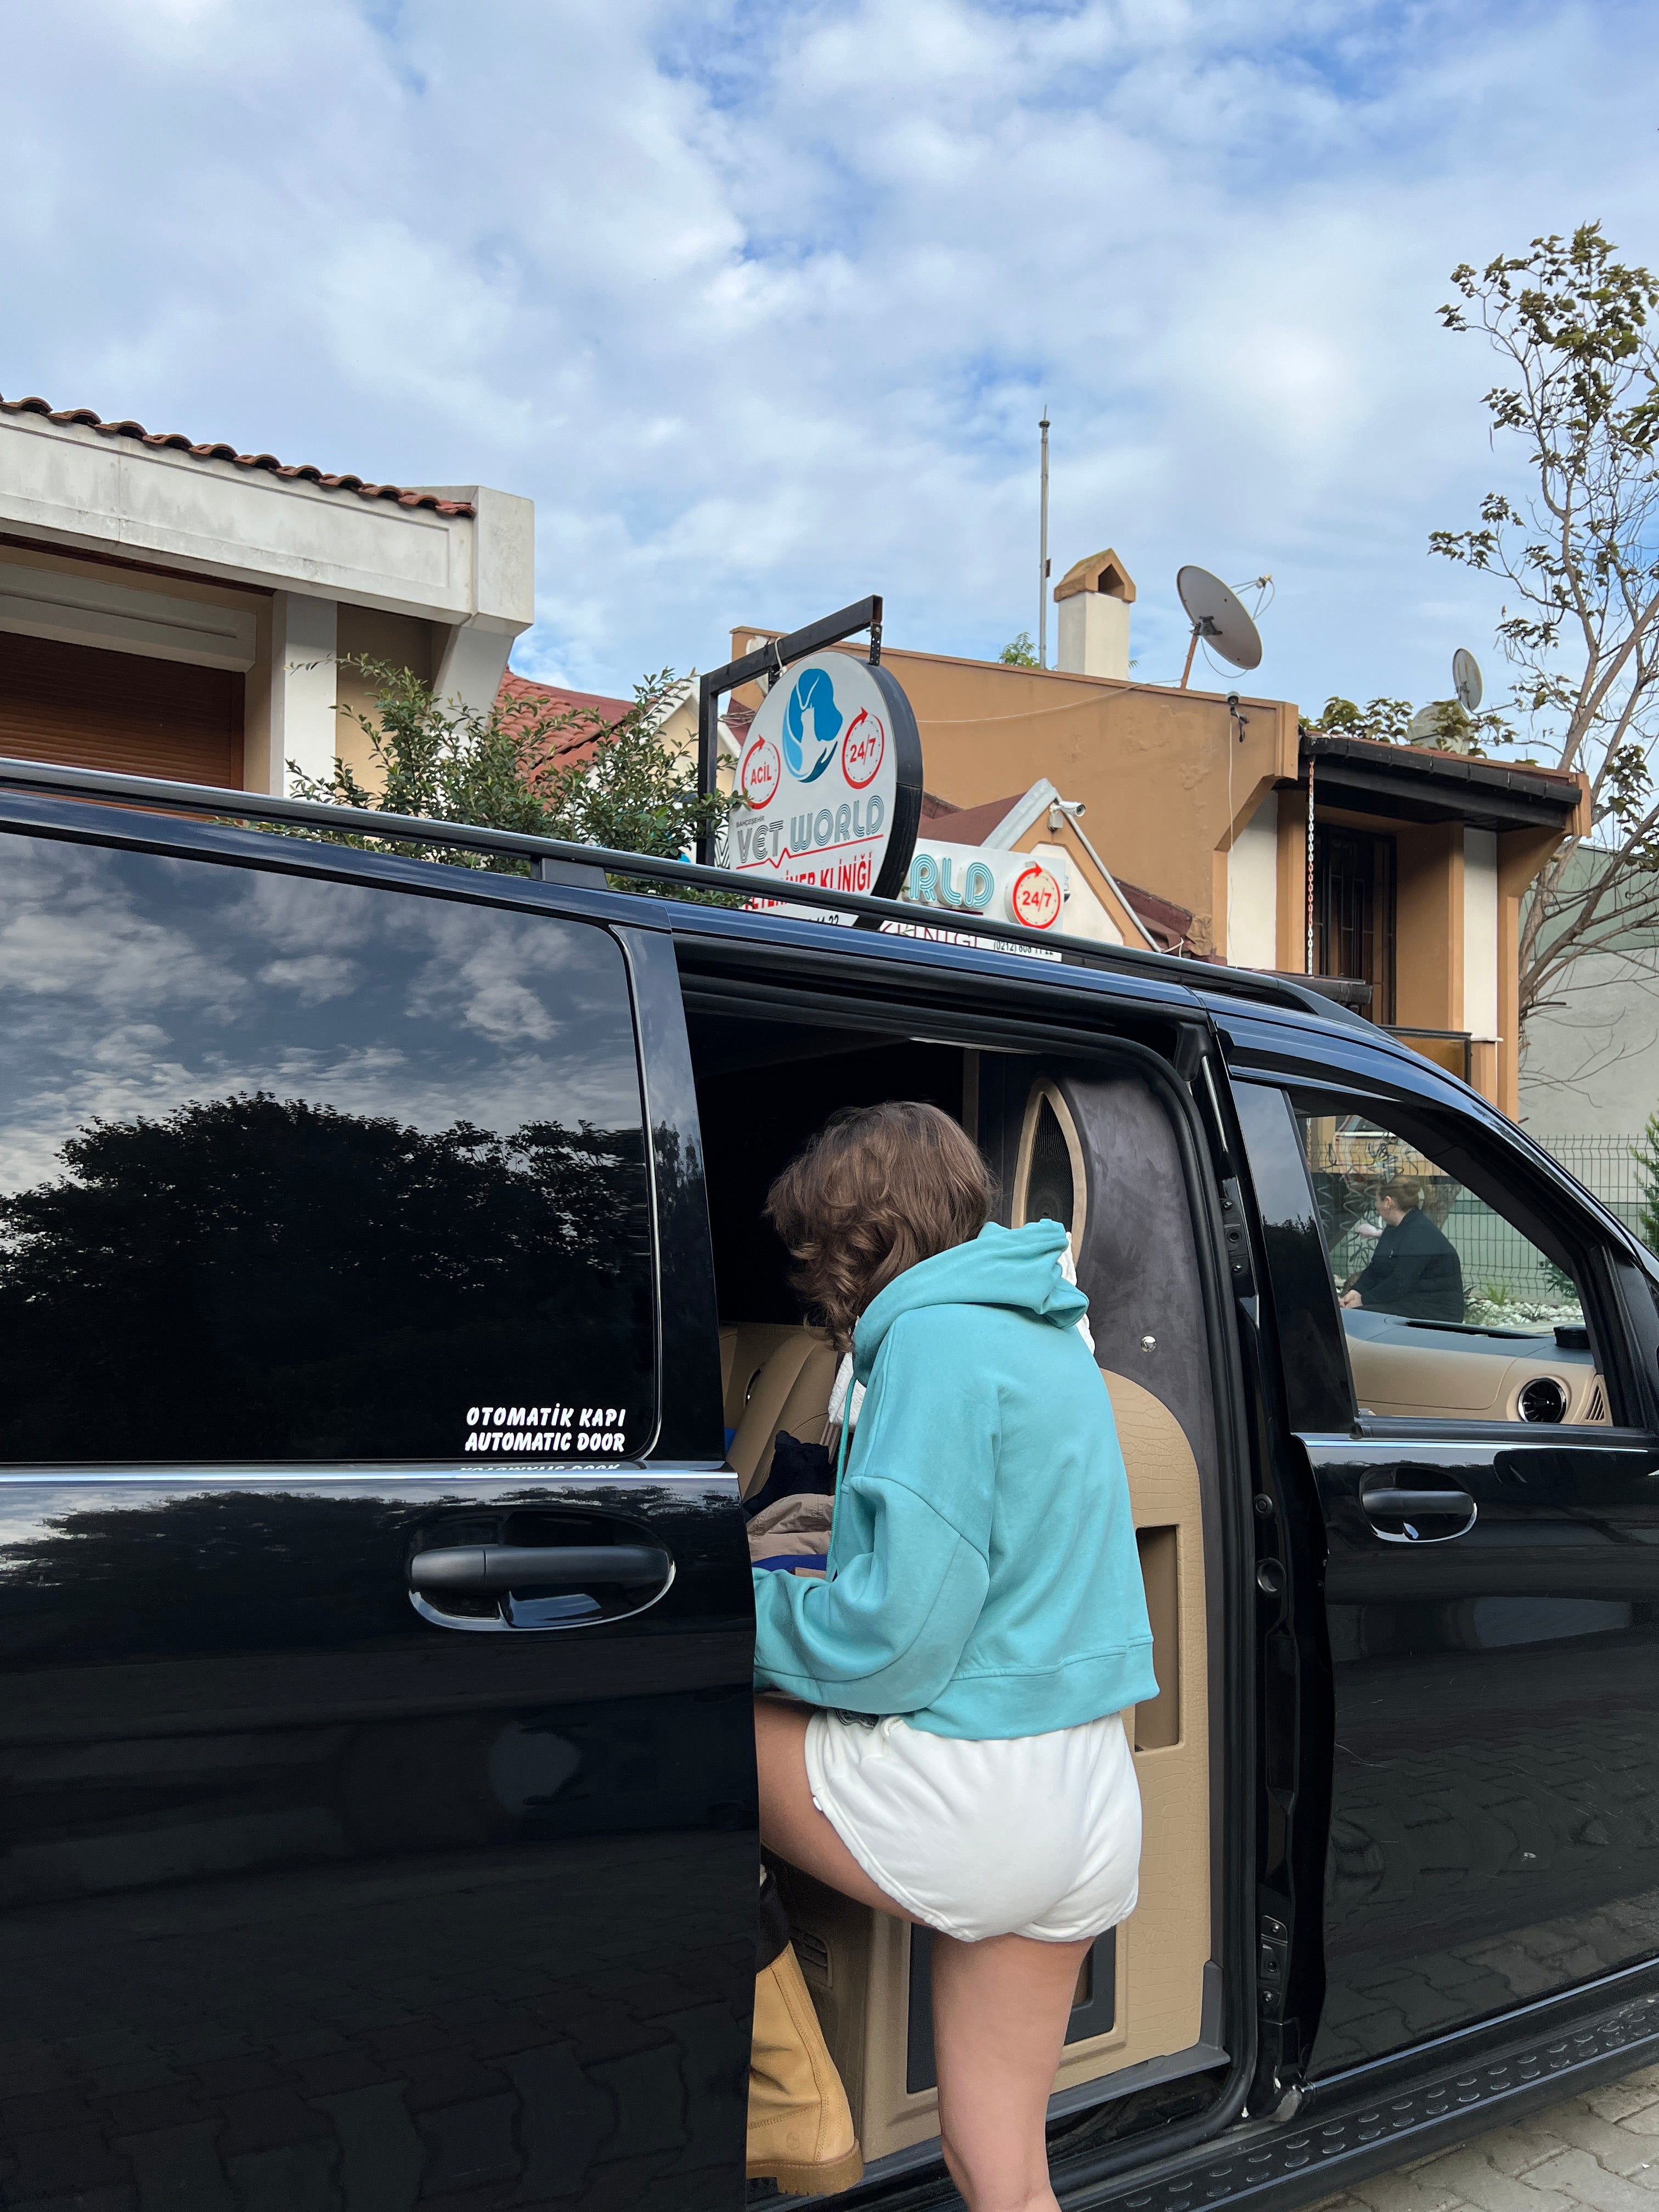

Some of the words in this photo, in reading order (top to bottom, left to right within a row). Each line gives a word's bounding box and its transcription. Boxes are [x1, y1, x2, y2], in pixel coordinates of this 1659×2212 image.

[850, 734, 877, 765] 24/7
[751, 761, 772, 786] ACİL
[737, 820, 783, 863] VET
[790, 795, 884, 852] WORLD
[909, 854, 995, 909] RLD
[1022, 888, 1052, 912] 24/7
[994, 940, 1017, 952] (0212)
[466, 1403, 574, 1427] OTOMATİK
[579, 1408, 626, 1427] KAPI
[465, 1432, 572, 1451] AUTOMATIC
[577, 1432, 625, 1452] DOOR
